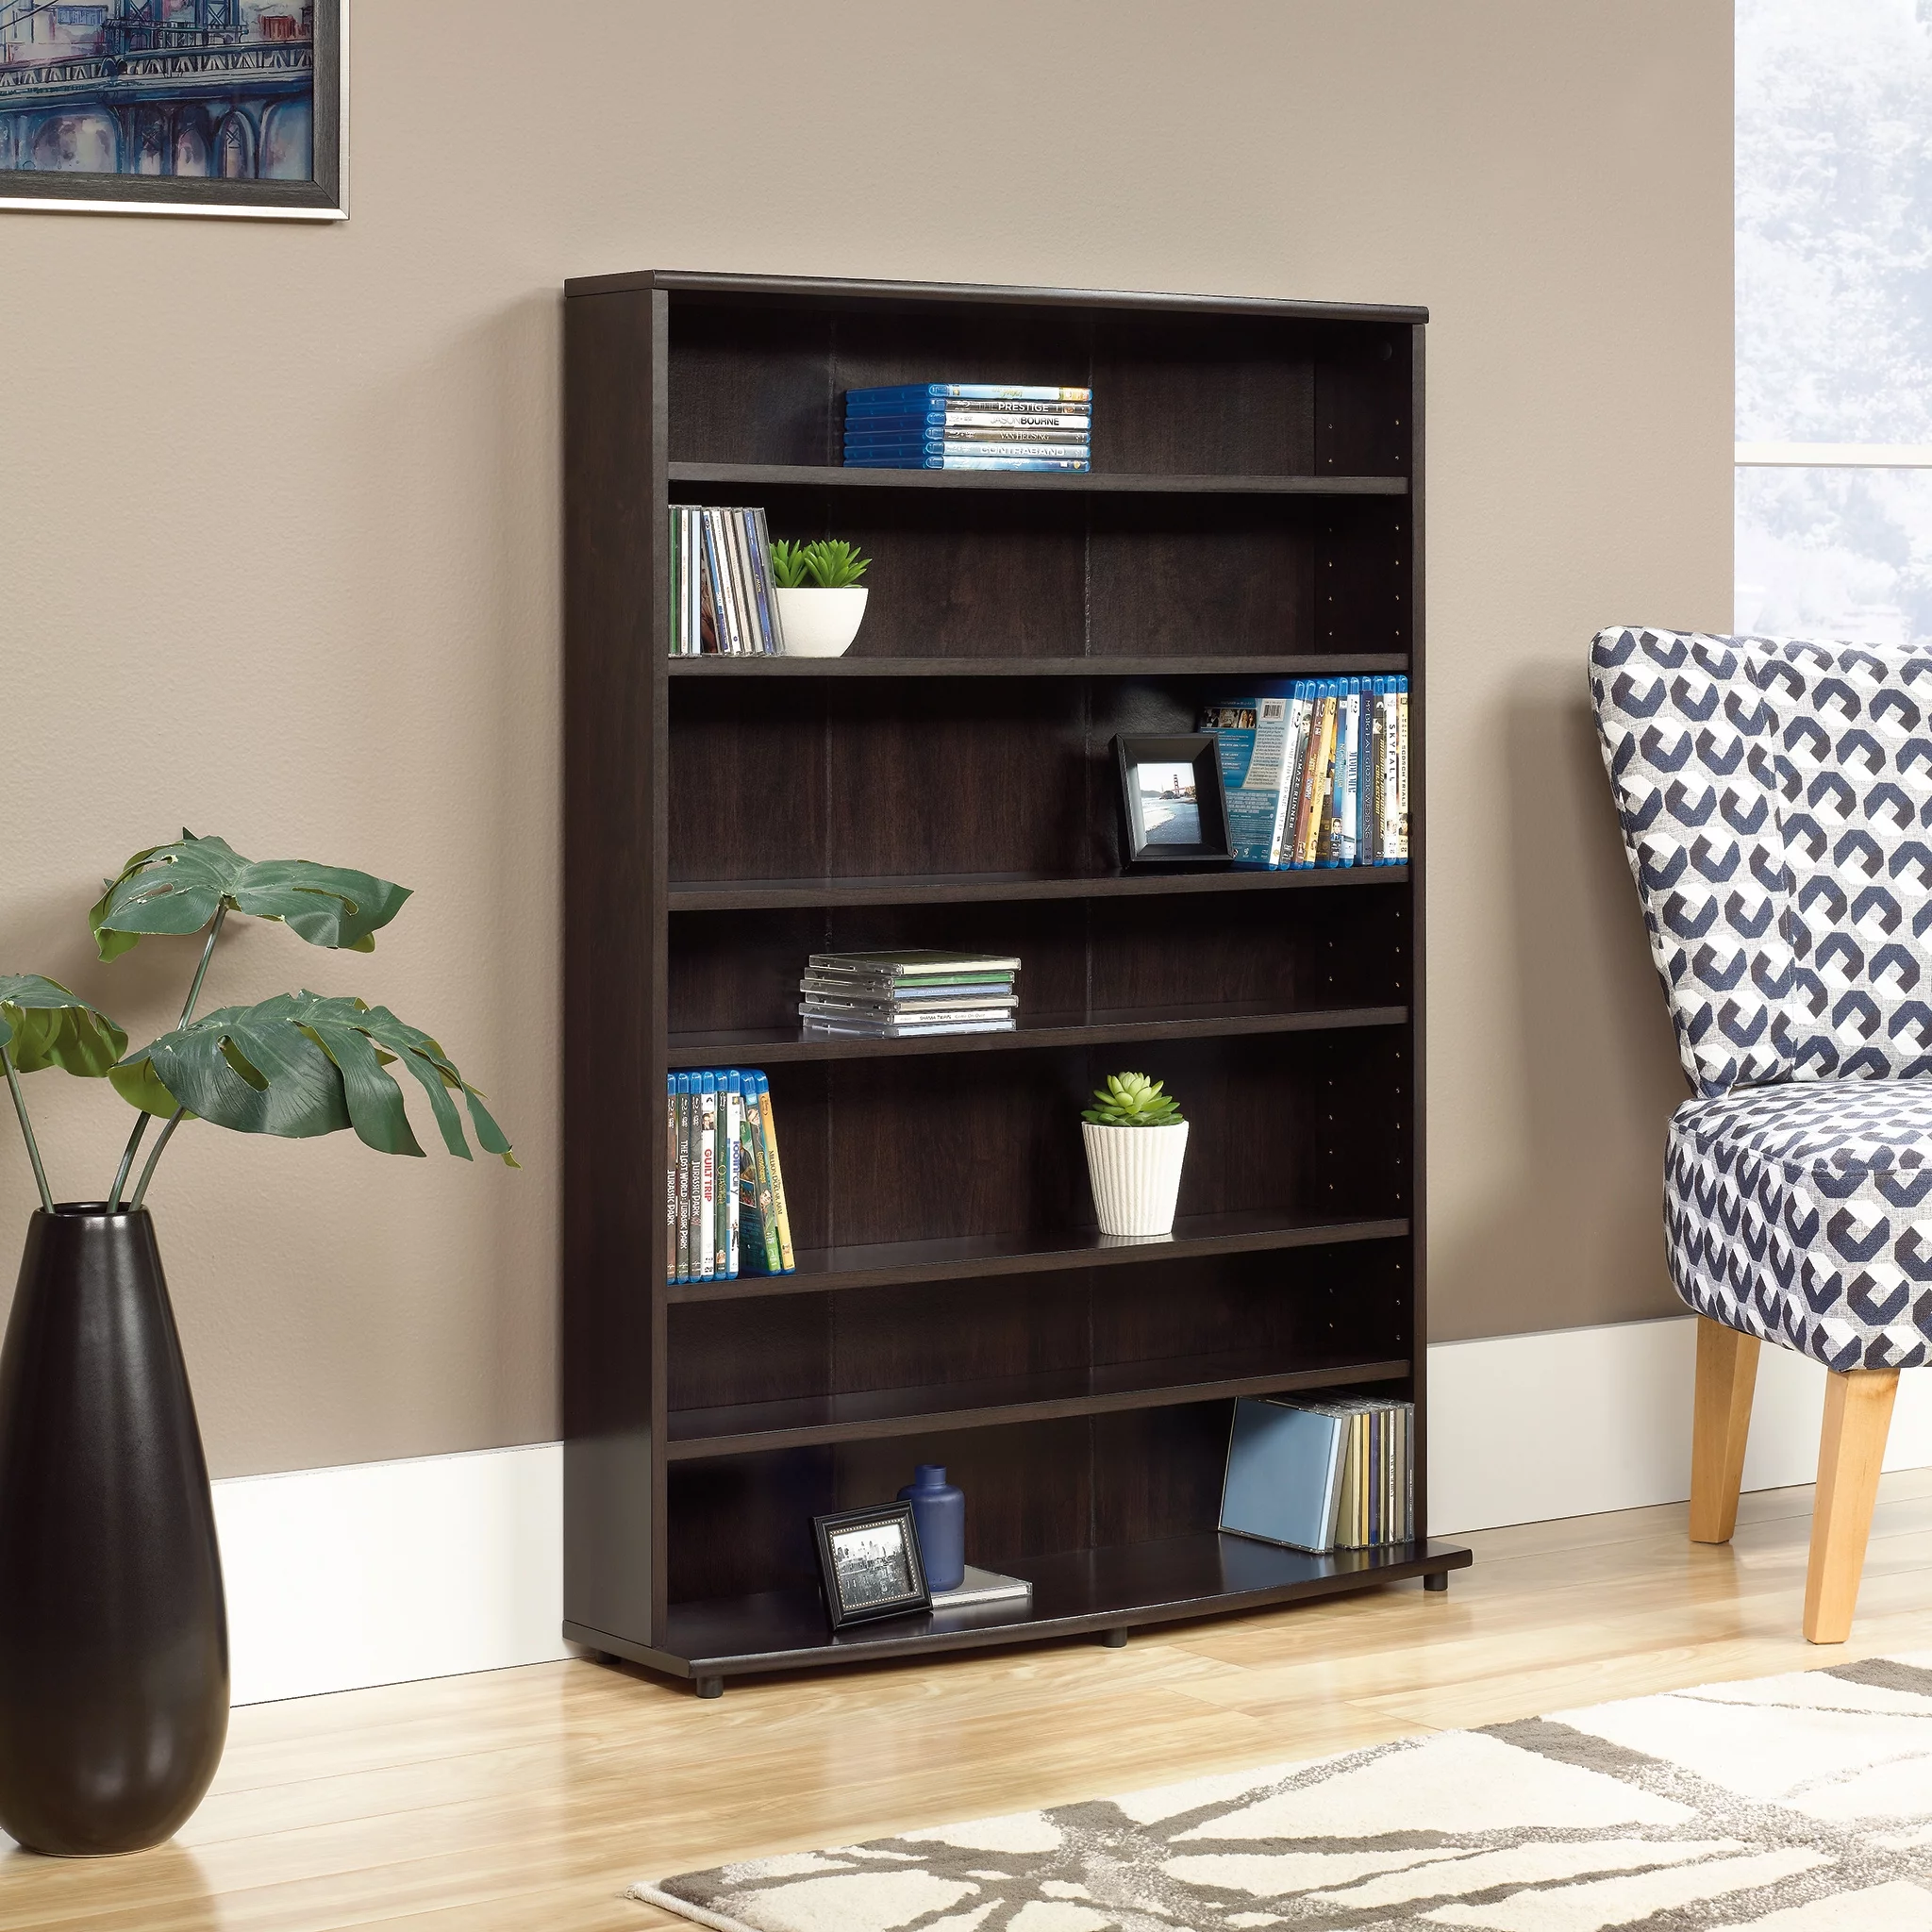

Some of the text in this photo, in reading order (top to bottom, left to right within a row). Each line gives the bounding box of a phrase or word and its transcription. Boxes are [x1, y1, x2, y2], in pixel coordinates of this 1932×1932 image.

[998, 402, 1049, 412] PRESTIGE
[991, 416, 1059, 426] JASON BOURNE
[1000, 430, 1050, 441] VAN HELSING
[981, 445, 1066, 457] CONTRABAND
[1365, 700, 1371, 711] MY
[1289, 791, 1299, 828] RUNNER
[680, 1155, 689, 1173] LOST
[704, 1148, 712, 1202] GUILT TRIP
[758, 1151, 766, 1184] Goosebumps
[667, 1170, 675, 1203] JURASSIC
[679, 1173, 688, 1200] WORLD:
[691, 1160, 701, 1194] JURASSIC
[773, 1175, 781, 1200] DOLLAR
[679, 1201, 688, 1229] JURASSIC
[691, 1195, 700, 1217] PARK
[679, 1229, 688, 1249] PARK
